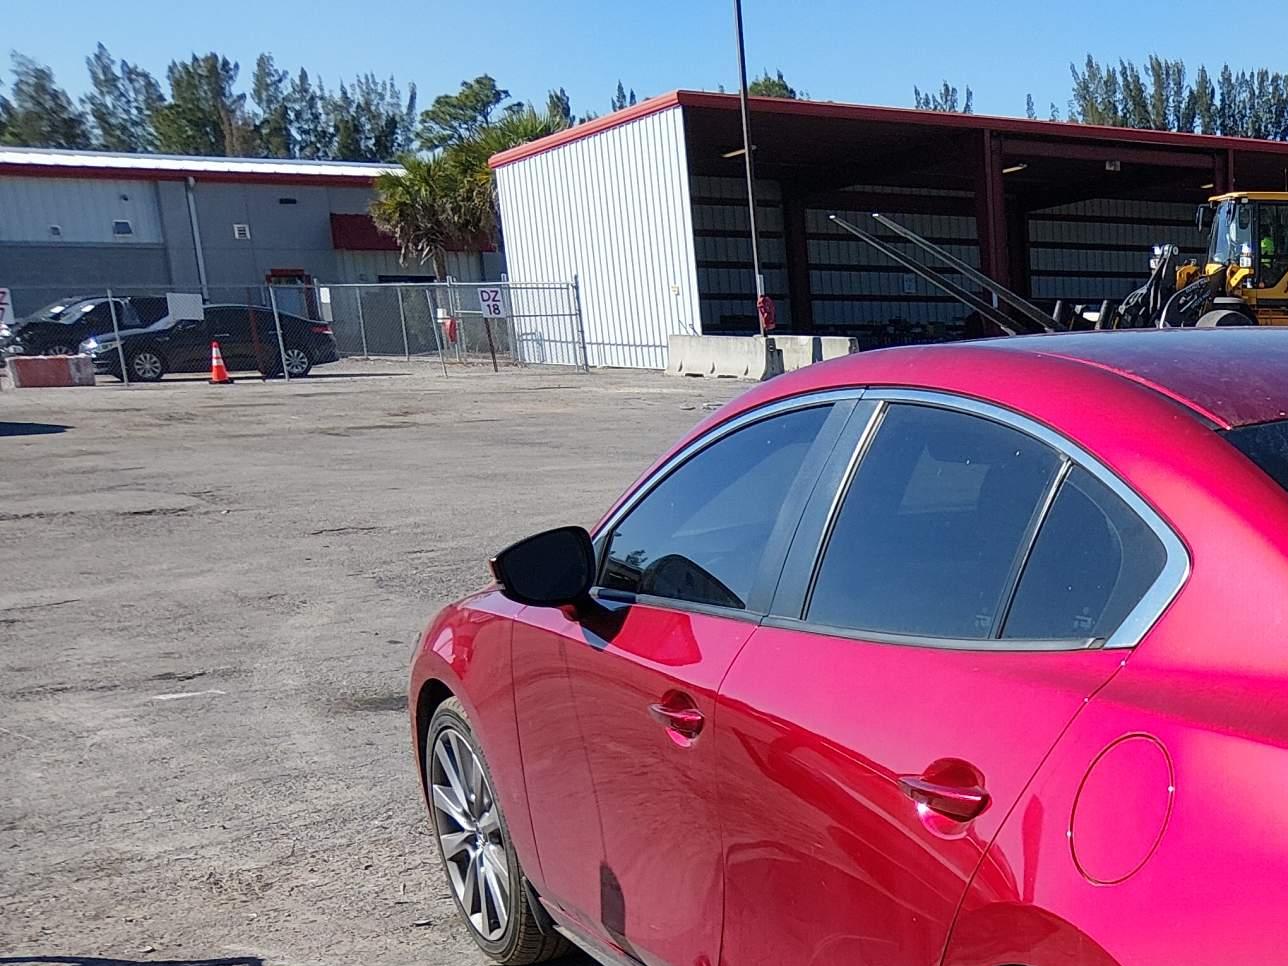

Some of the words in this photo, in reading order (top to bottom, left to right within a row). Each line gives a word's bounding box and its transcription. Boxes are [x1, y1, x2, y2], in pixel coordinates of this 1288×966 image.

[0, 291, 9, 305] Z
[480, 290, 501, 302] DZ
[486, 303, 501, 315] 18
